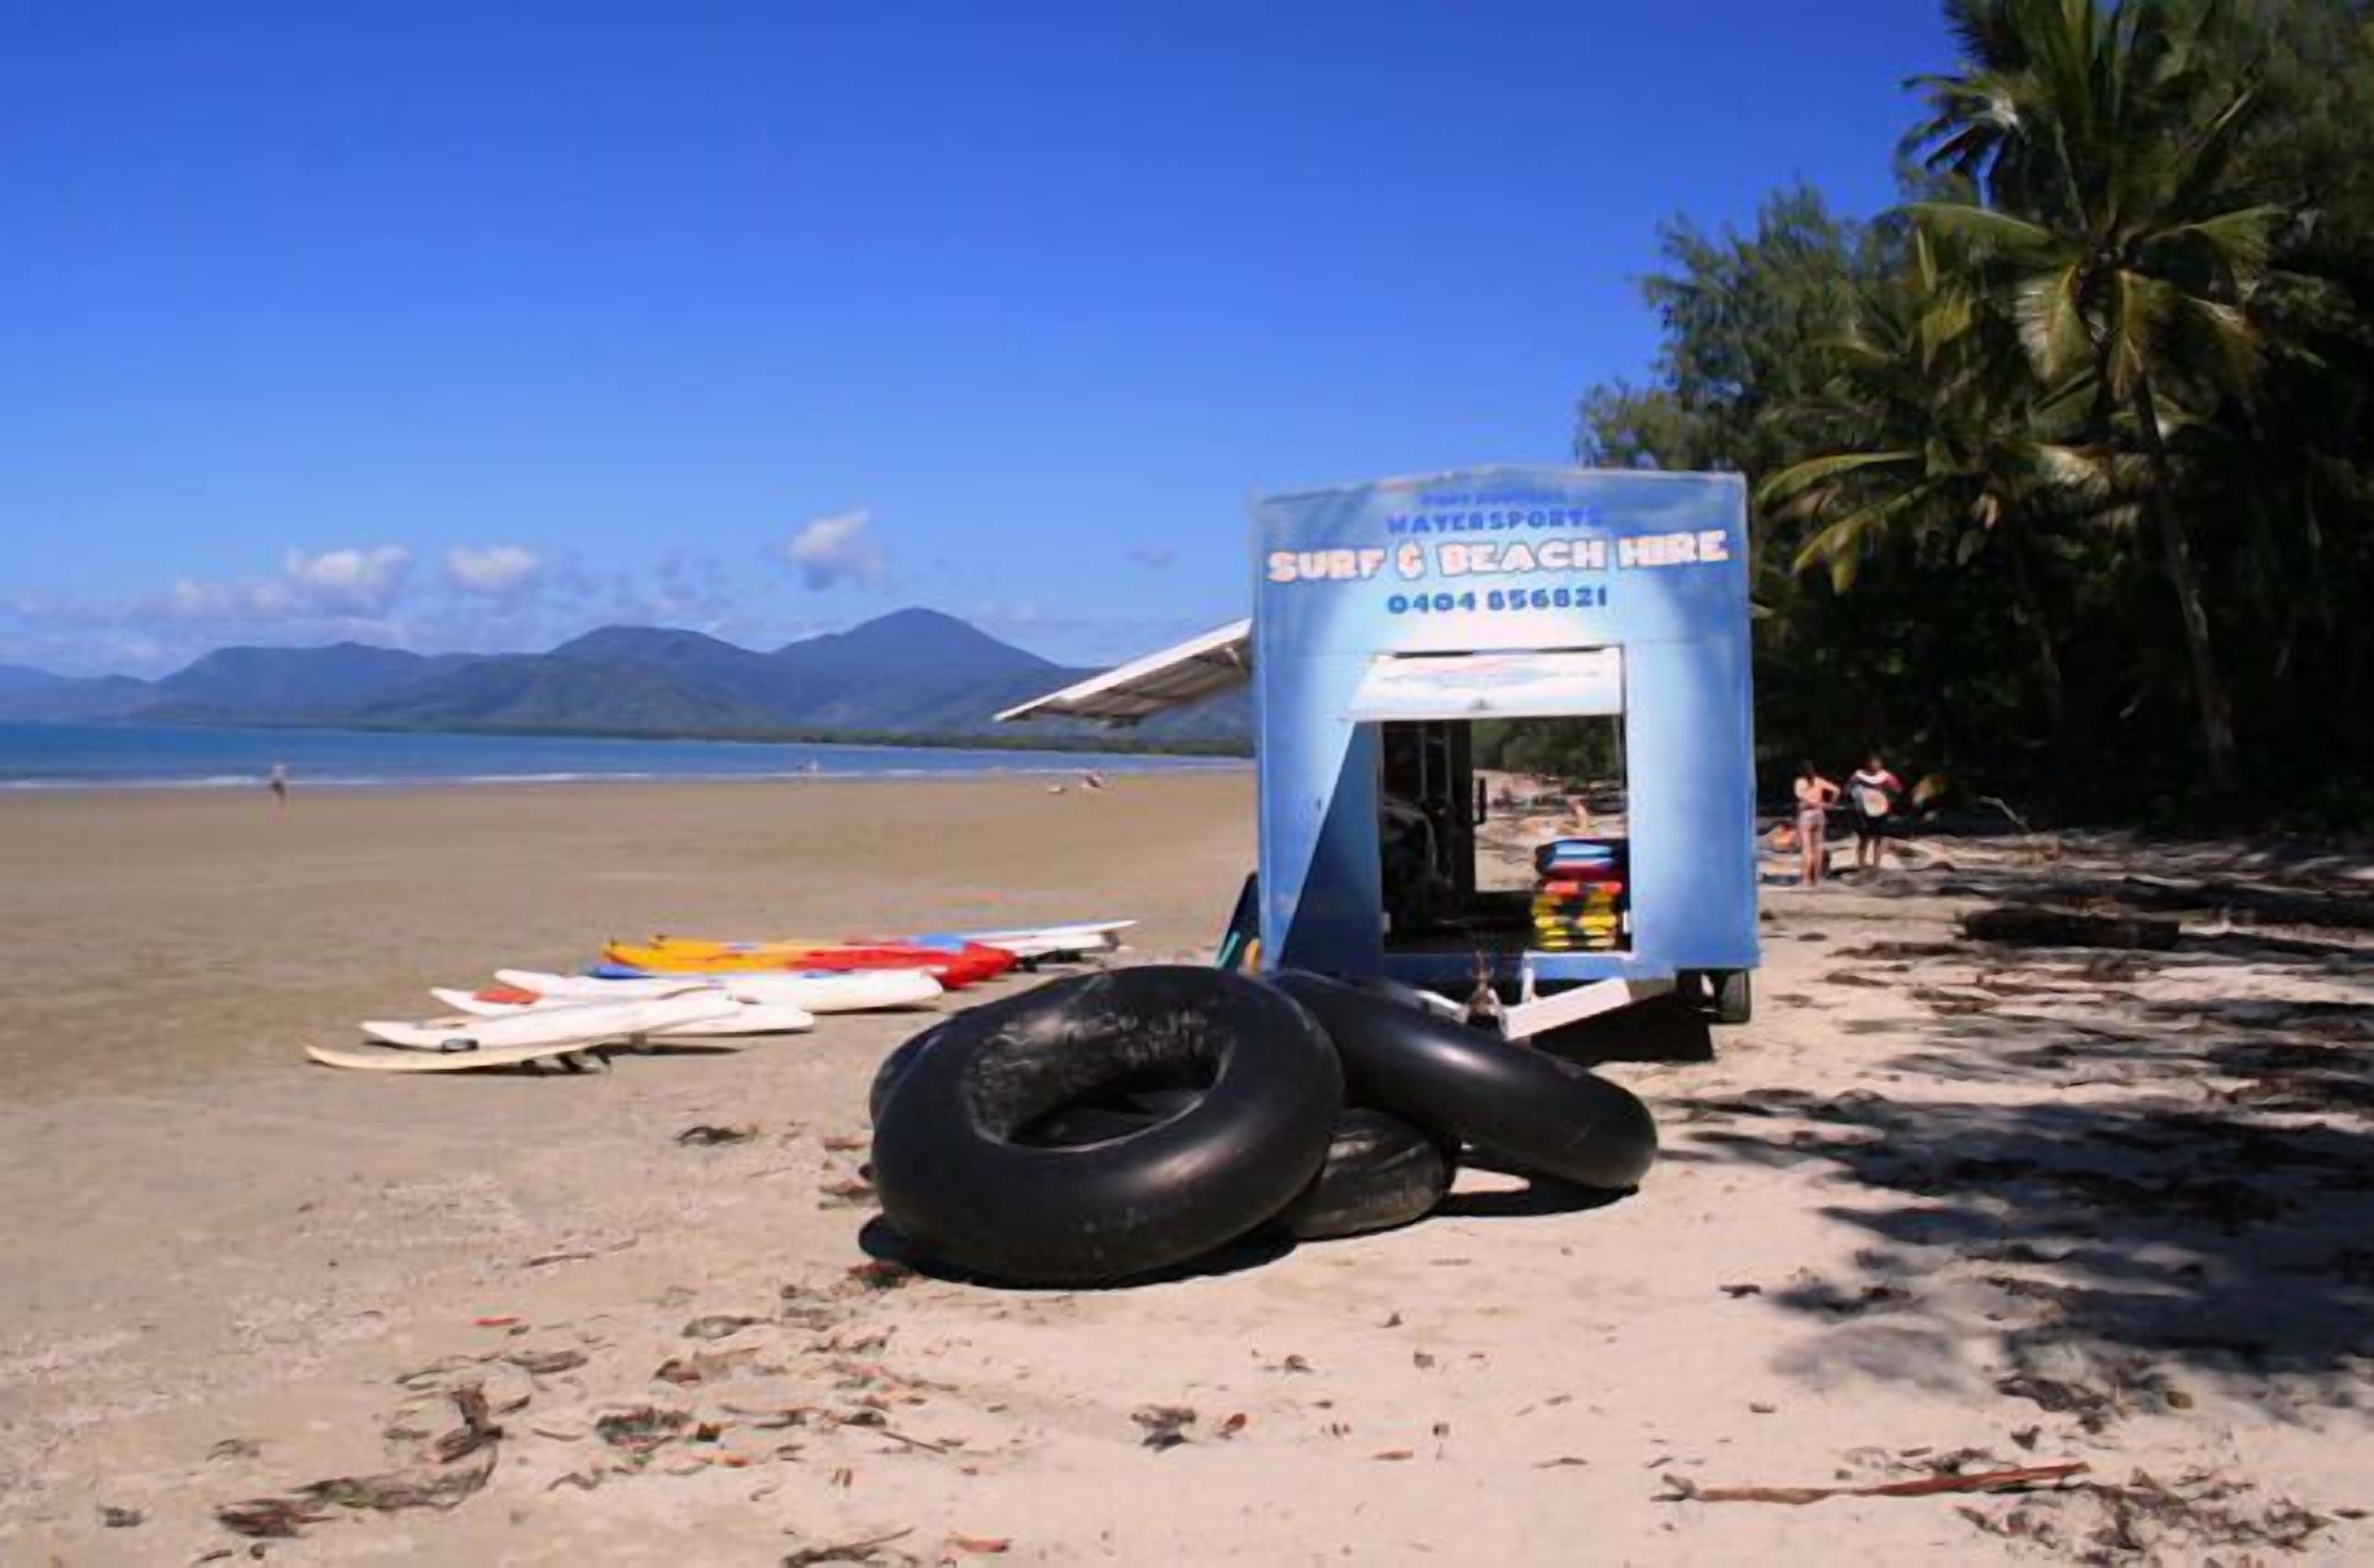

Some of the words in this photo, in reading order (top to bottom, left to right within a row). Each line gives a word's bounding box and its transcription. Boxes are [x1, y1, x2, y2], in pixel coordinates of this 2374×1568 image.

[1387, 509, 1603, 533] WATERSPORTS
[1268, 550, 1384, 582] SURF
[1397, 541, 1424, 580] &
[1437, 541, 1606, 576] BEACH
[1618, 529, 1730, 569] HIRE
[1388, 592, 1476, 615] 0404
